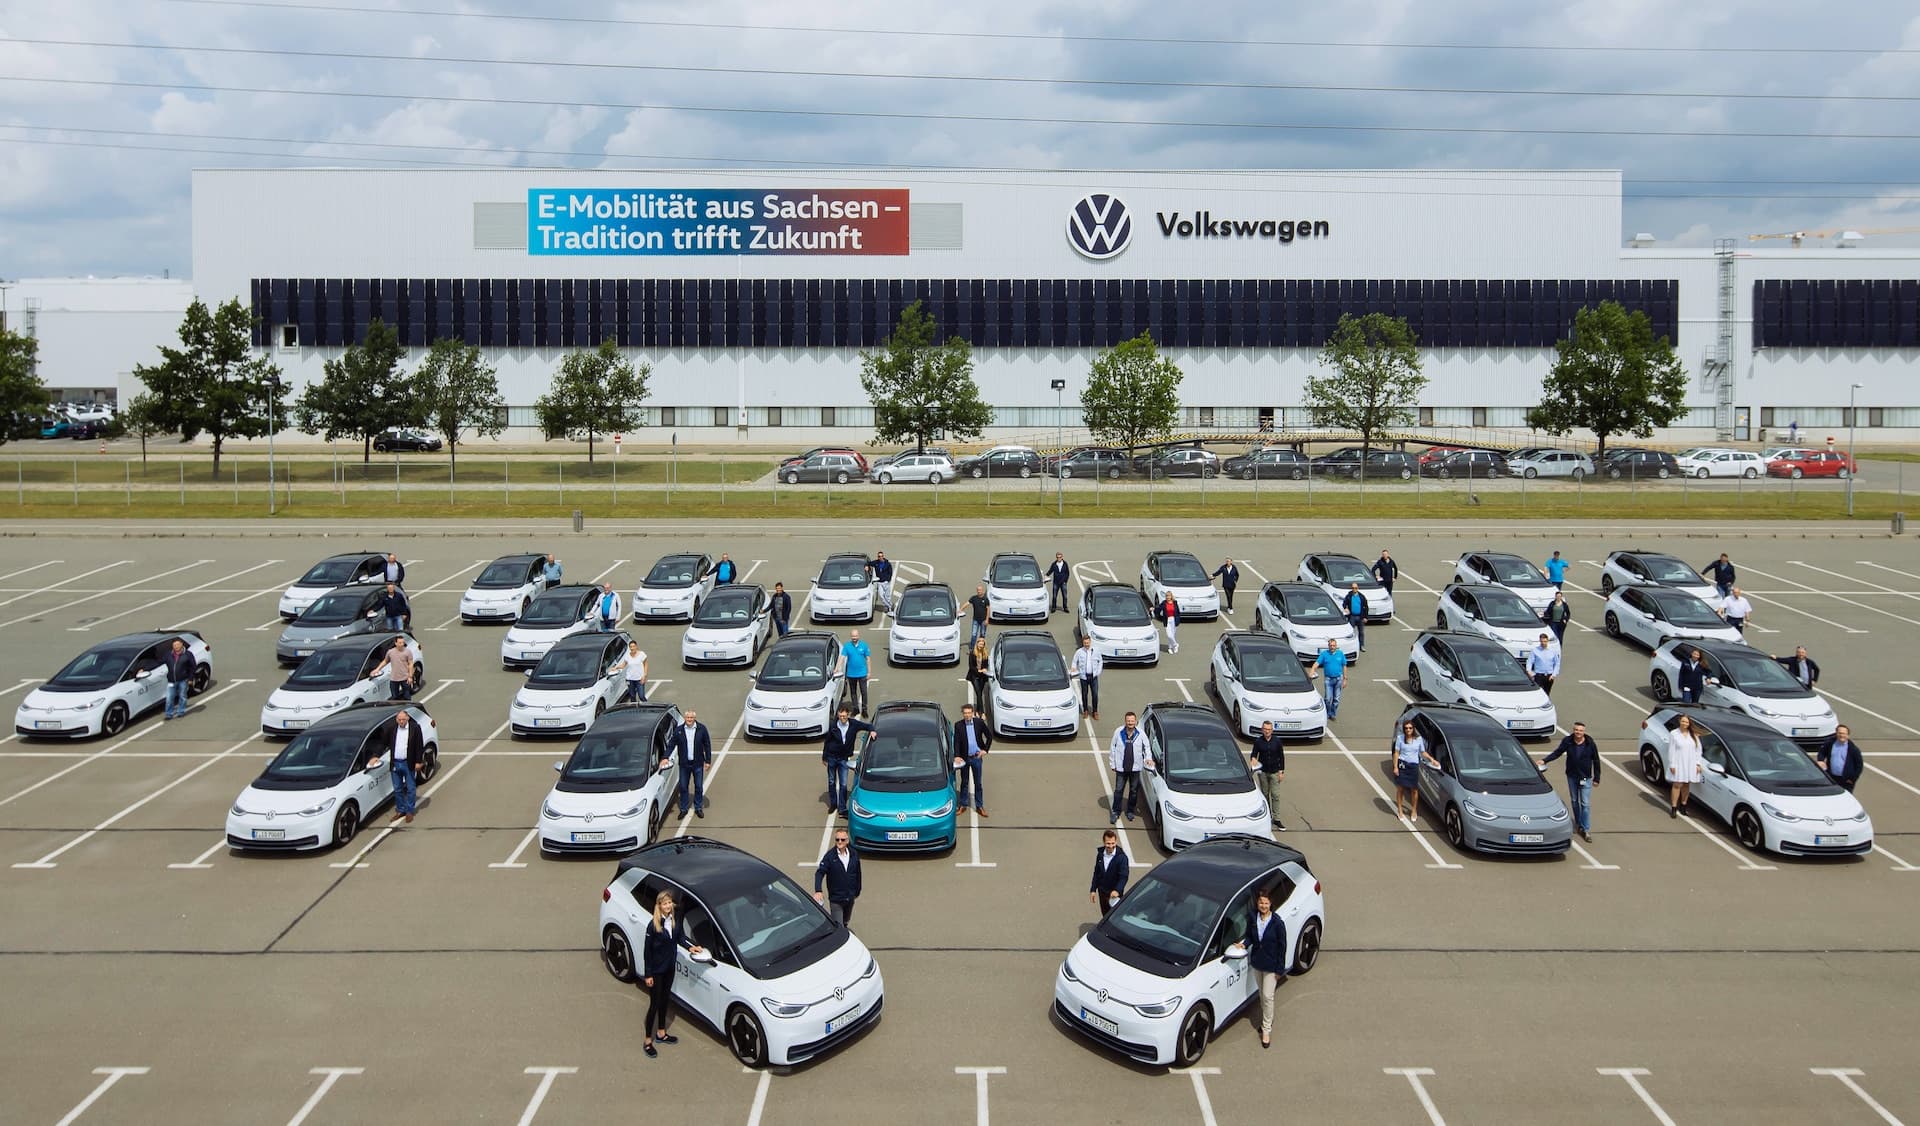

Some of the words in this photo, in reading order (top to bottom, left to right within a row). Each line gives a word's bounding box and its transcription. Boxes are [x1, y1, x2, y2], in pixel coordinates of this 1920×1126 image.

[538, 194, 697, 219] E-Mobilität
[705, 201, 755, 219] aus
[763, 194, 878, 219] Sachsen
[538, 225, 663, 250] Tradition
[672, 225, 741, 250] trifft
[750, 225, 863, 250] Zukunft
[1157, 210, 1330, 243] Volkswagen
[1226, 969, 1241, 989] ID.3
